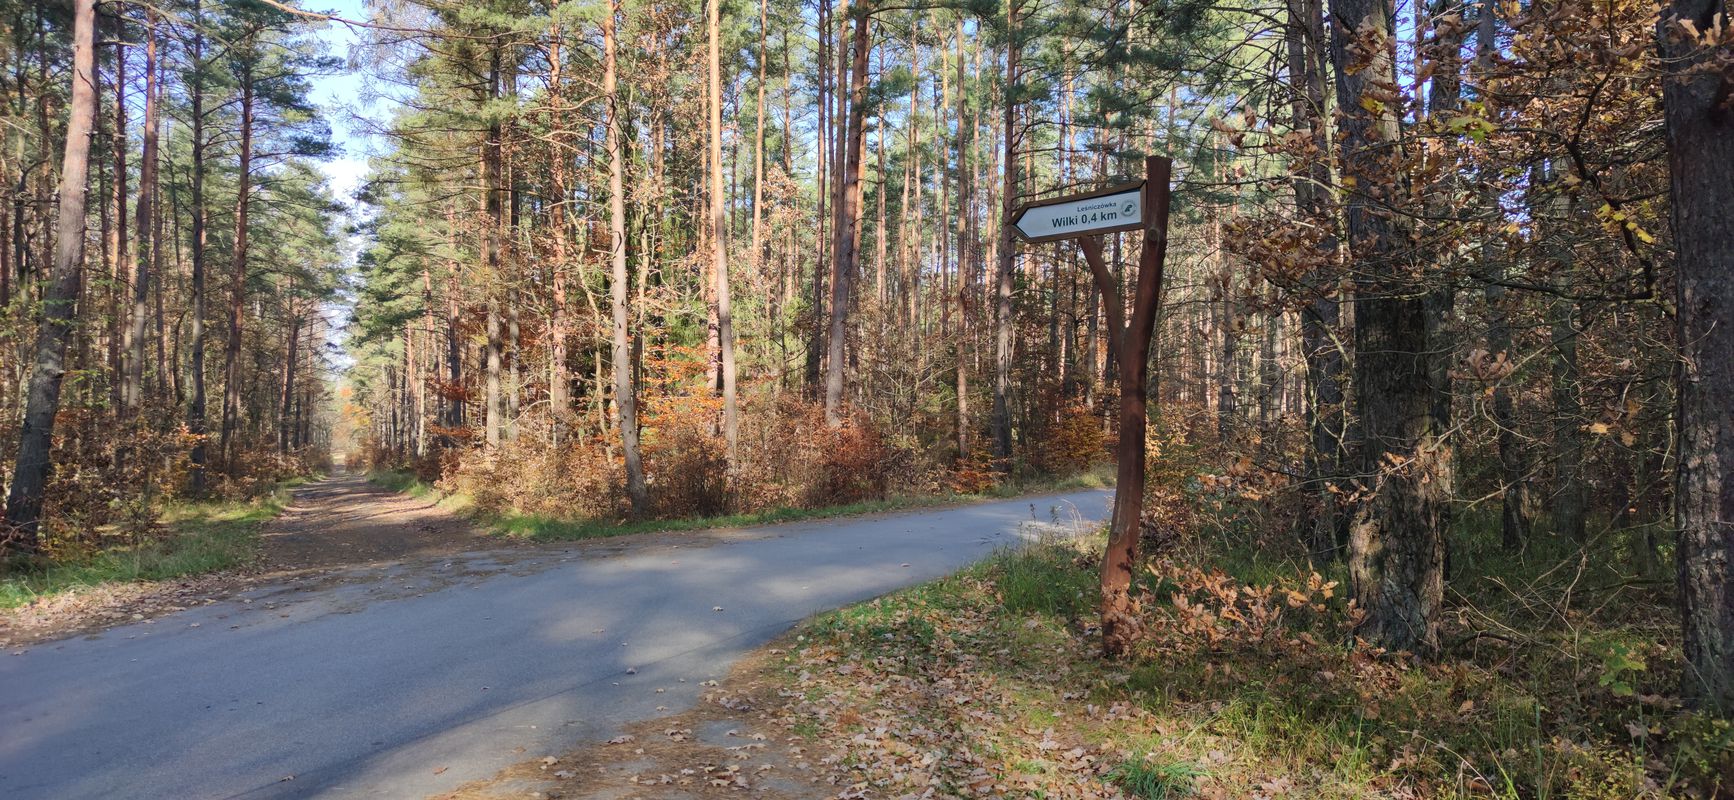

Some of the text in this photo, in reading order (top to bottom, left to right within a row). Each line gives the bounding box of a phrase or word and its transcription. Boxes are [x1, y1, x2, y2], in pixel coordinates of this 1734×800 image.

[1077, 202, 1117, 212] Leśniczówka
[1052, 211, 1117, 228] Wilki 0,4 km
